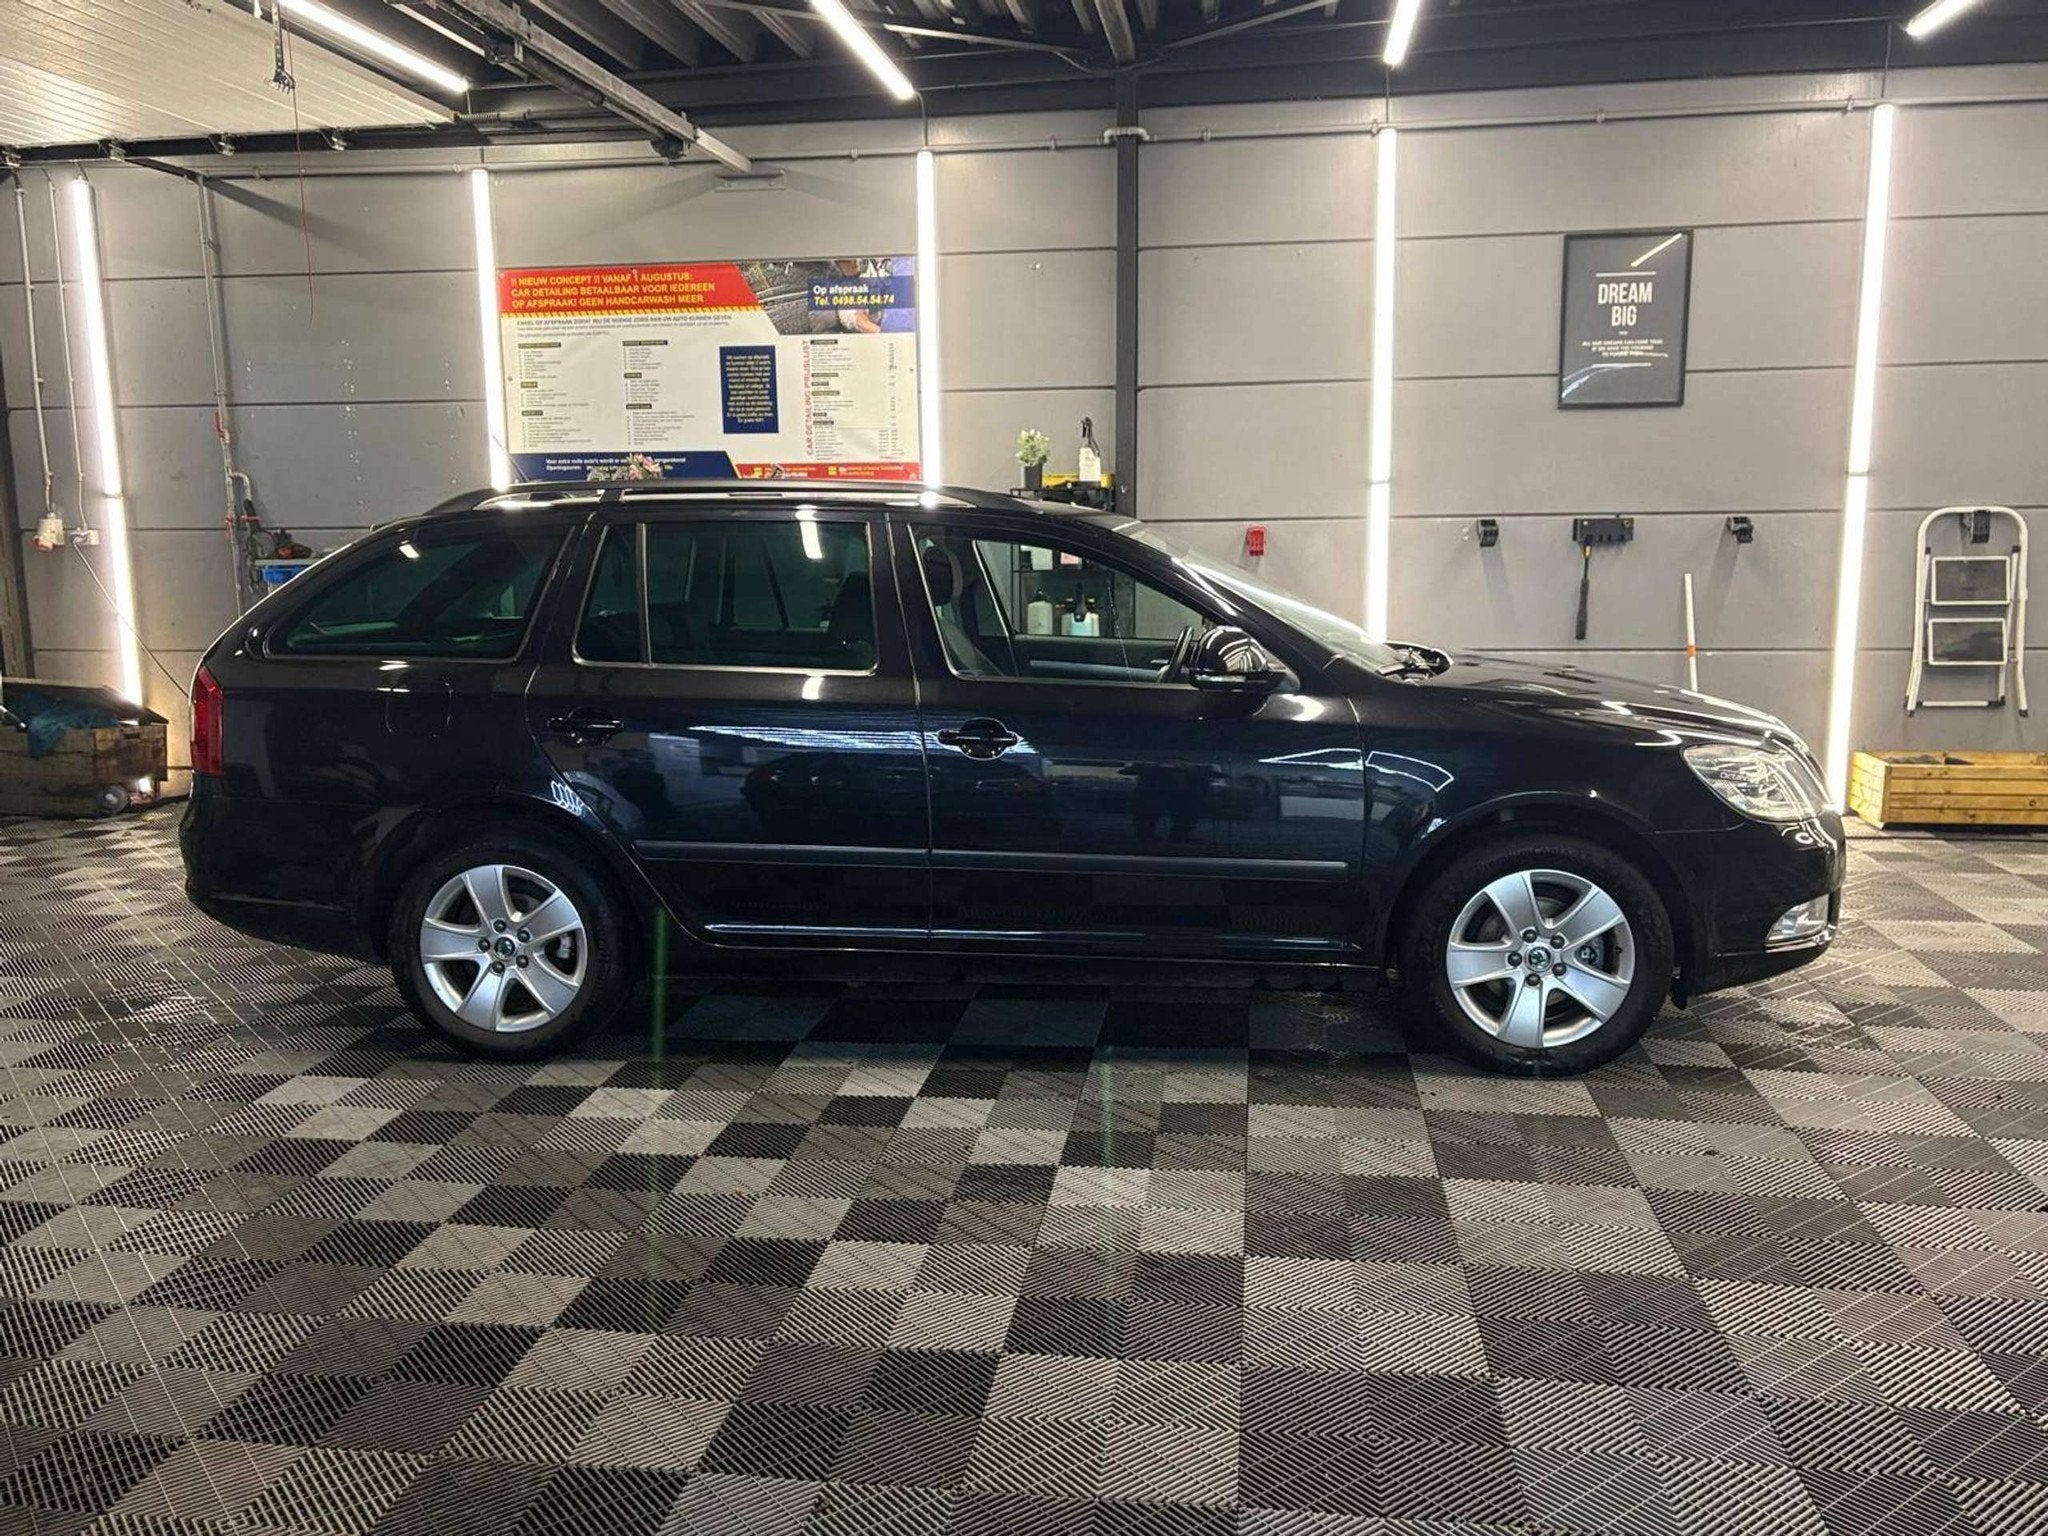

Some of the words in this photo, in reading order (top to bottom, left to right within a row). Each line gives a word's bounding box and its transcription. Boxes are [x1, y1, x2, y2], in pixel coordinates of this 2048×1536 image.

[518, 277, 547, 286] NIEUW
[549, 275, 592, 285] CONCEPT
[601, 273, 631, 283] VANAF
[511, 288, 531, 297] CAR
[532, 286, 578, 297] DETAILING
[580, 284, 640, 295] BETAALBAAR
[641, 283, 668, 293] VOOR
[669, 281, 716, 292] IEDEREEN
[813, 285, 827, 296] Op
[829, 283, 869, 295] afspraak
[1597, 281, 1653, 304] DREAM
[512, 299, 525, 309] OP
[579, 297, 604, 306] GEEN
[605, 295, 676, 306] HANDCARWASH
[677, 294, 704, 304] MEER
[814, 296, 830, 306] Tel.
[1611, 305, 1637, 327] BIG
[804, 390, 813, 435] DETAILING
